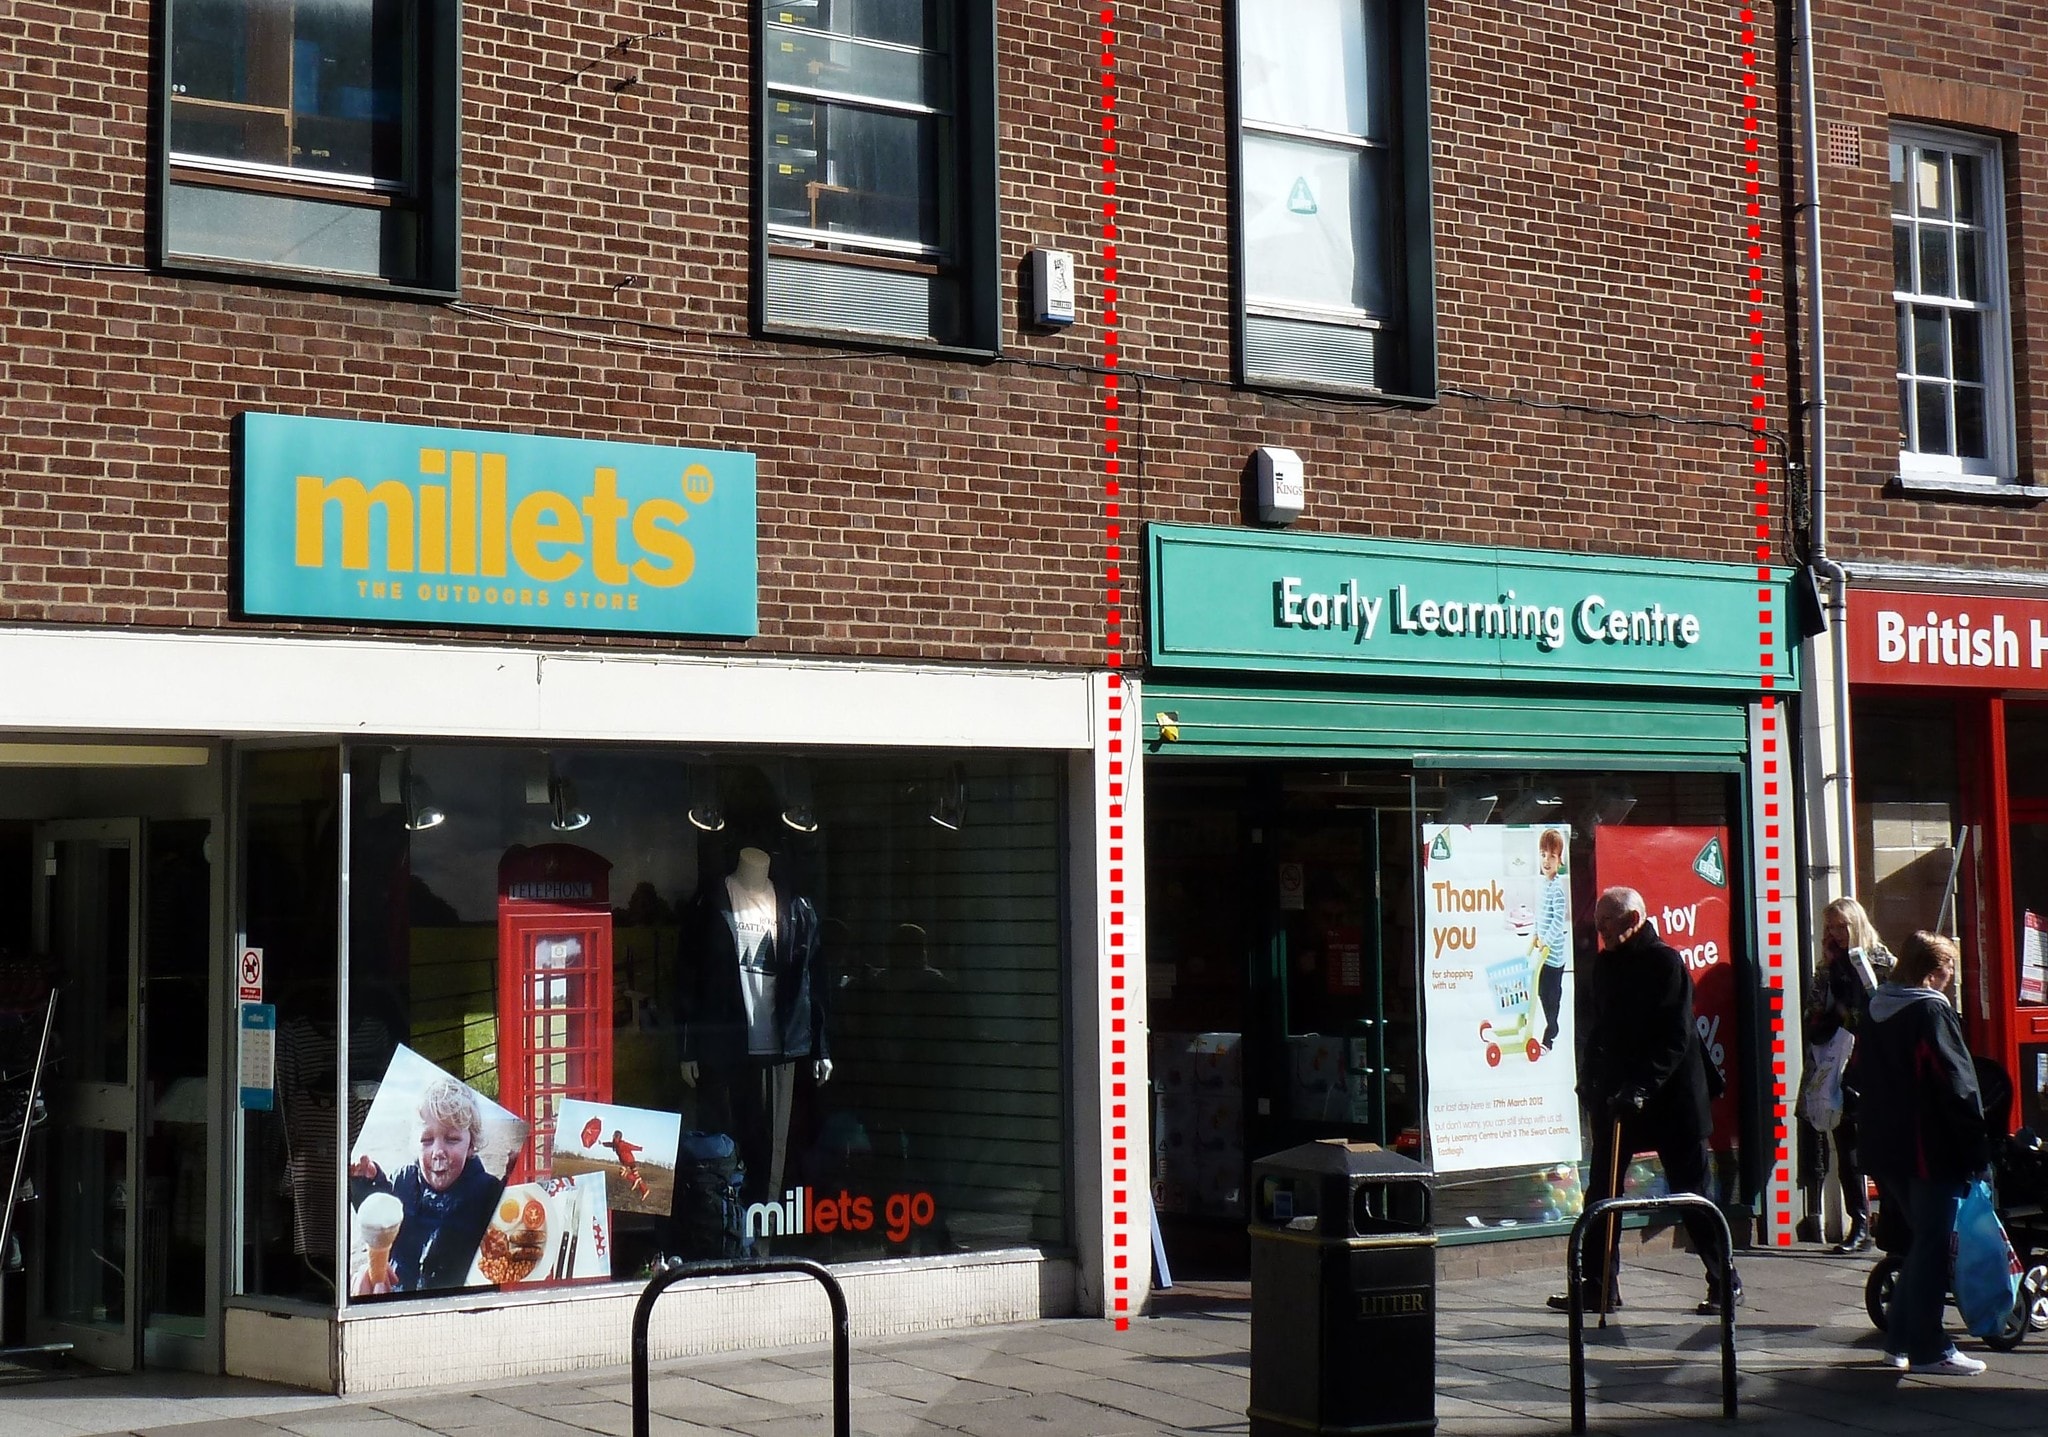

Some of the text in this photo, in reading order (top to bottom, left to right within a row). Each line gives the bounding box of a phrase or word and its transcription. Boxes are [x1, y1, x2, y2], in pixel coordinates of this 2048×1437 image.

[296, 448, 696, 588] millets
[357, 580, 639, 611] THE OUTDOORS STORE
[1281, 576, 1700, 649] Early Learning Centre
[1877, 610, 2020, 668] British
[510, 882, 590, 898] TELEPHONE
[1432, 880, 1504, 913] Thank
[1663, 903, 1697, 937] toy
[1433, 926, 1477, 960] you
[1432, 969, 1474, 981] for shopping
[1432, 980, 1457, 990] with us
[1493, 1099, 1505, 1108] 17th
[1507, 1098, 1528, 1107] March
[1529, 1096, 1543, 1106] 2012
[1436, 1134, 1450, 1144] Early
[1452, 1132, 1477, 1143] Learning
[1479, 1131, 1498, 1140] Centre
[1499, 1129, 1511, 1139] Unit
[1519, 1128, 1530, 1137] The
[1531, 1127, 1547, 1136] Swan
[746, 1186, 935, 1243] millets go
[1361, 1293, 1424, 1314] LITTER
